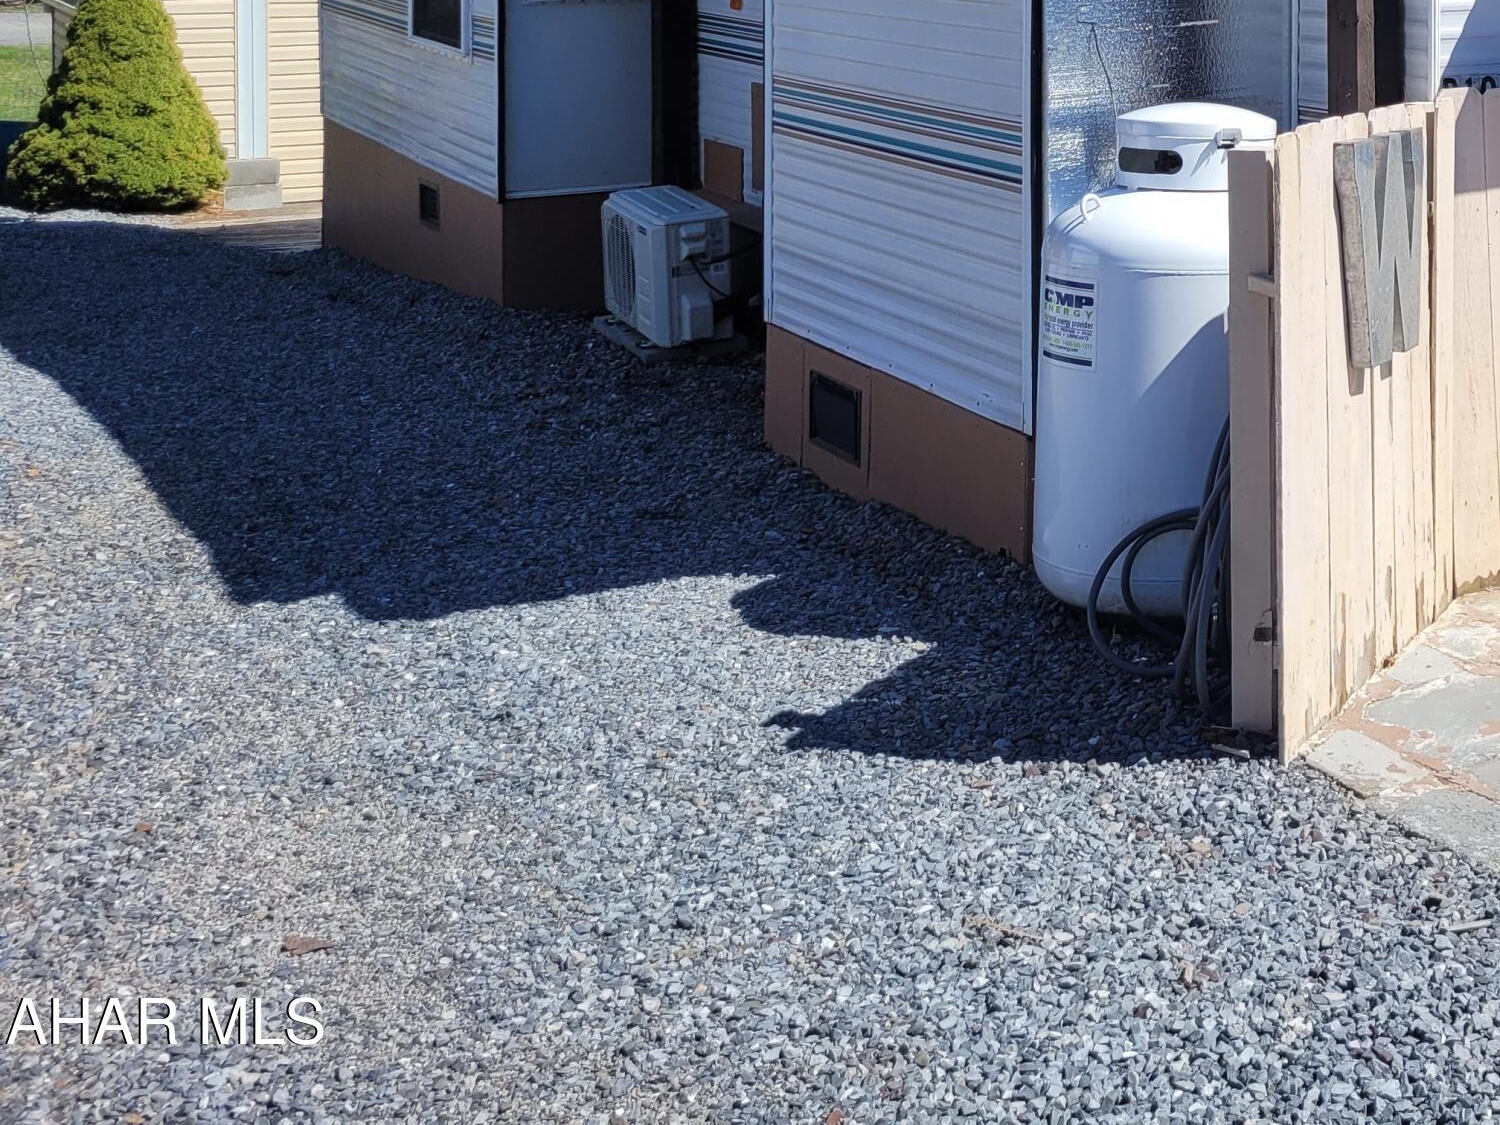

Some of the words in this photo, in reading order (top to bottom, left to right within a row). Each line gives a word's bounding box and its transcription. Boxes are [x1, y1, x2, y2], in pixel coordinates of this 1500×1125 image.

[1333, 127, 1425, 368] W
[1044, 287, 1094, 309] CMP
[1044, 301, 1094, 322] ENERGY
